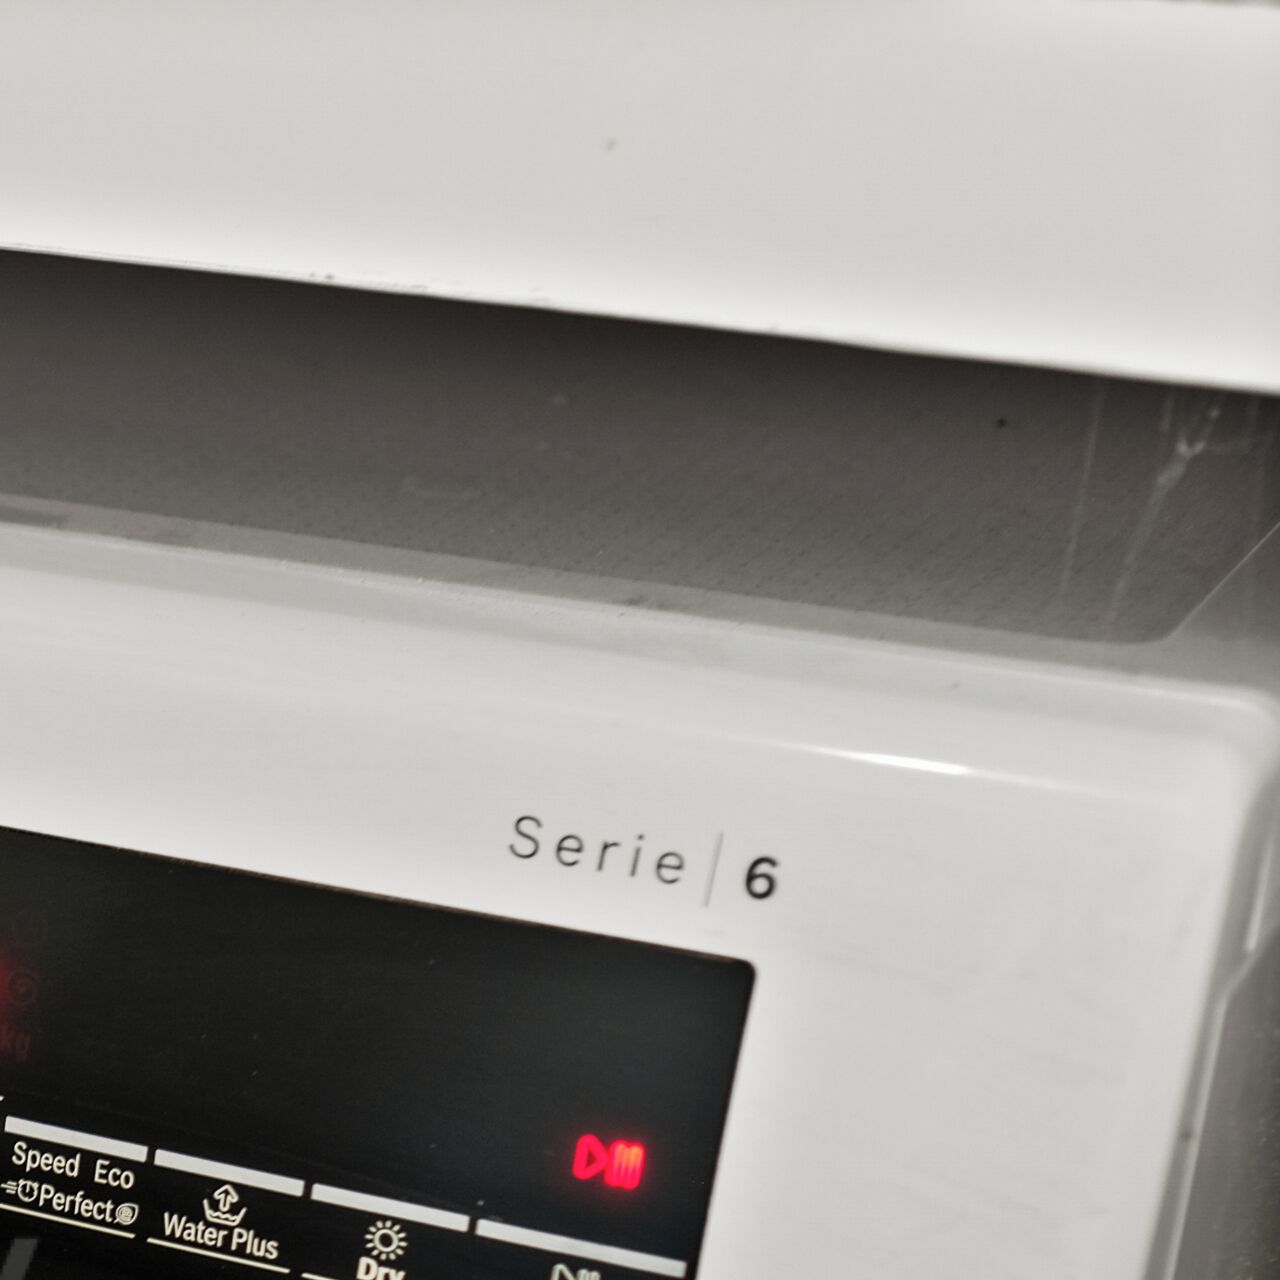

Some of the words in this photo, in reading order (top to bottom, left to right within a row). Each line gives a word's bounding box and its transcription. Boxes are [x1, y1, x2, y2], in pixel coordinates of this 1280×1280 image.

[508, 815, 686, 884] Serie
[744, 855, 780, 901] 6
[11, 1140, 81, 1177] Speed
[94, 1159, 135, 1190] Eco
[39, 1183, 114, 1223] Perfect
[163, 1211, 228, 1249] Water
[232, 1227, 280, 1260] Plus
